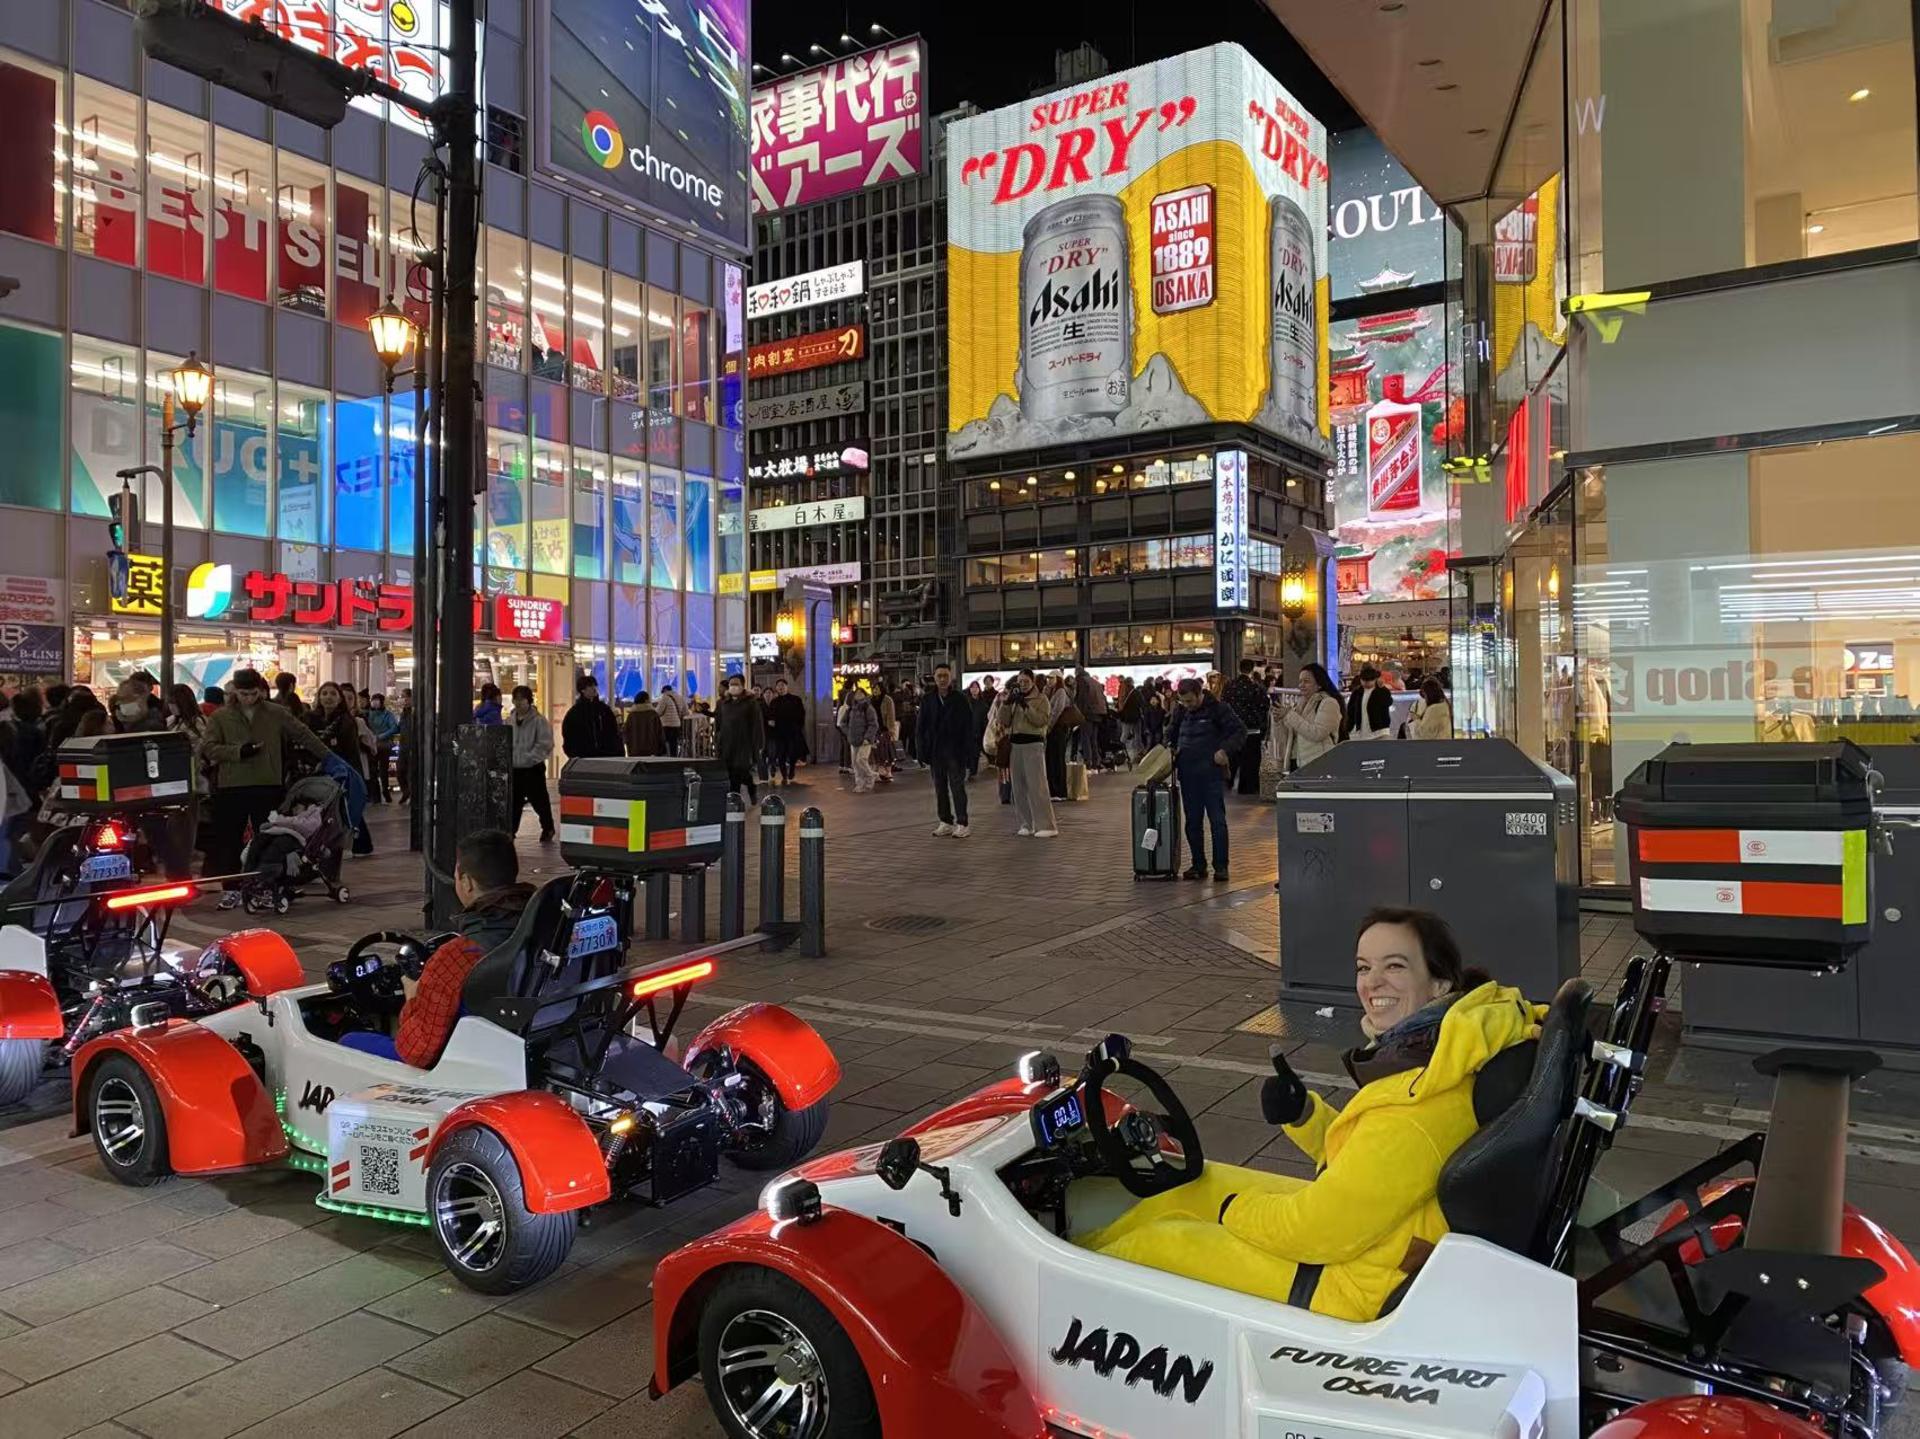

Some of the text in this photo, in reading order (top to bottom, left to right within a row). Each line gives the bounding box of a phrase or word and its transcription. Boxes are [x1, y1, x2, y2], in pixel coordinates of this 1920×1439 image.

[1029, 80, 1131, 132] SUPER
[1274, 96, 1310, 142] SUPER
[629, 146, 722, 207] chrome
[98, 162, 270, 251] BEST
[1154, 195, 1209, 235] ASAHI
[1326, 186, 1446, 239] OUT
[1058, 238, 1091, 251] SUPER
[1168, 229, 1194, 243] since
[1154, 237, 1209, 274] 1889
[1030, 268, 1119, 327] Asahi
[1155, 271, 1209, 307] OSAKA
[1275, 269, 1313, 328] Asahi
[1063, 321, 1085, 341] 生
[748, 348, 795, 370] 肉割烹
[1048, 352, 1102, 370] スーパードライ
[795, 503, 847, 525] 白木屋
[507, 598, 552, 612] SUNDRUG
[580, 934, 605, 952] 7730
[298, 1080, 336, 1115] JAP
[1048, 1315, 1214, 1404] JAPAN
[1270, 1345, 1510, 1390] FUTURE KART
[1322, 1376, 1441, 1405] OSAKA
